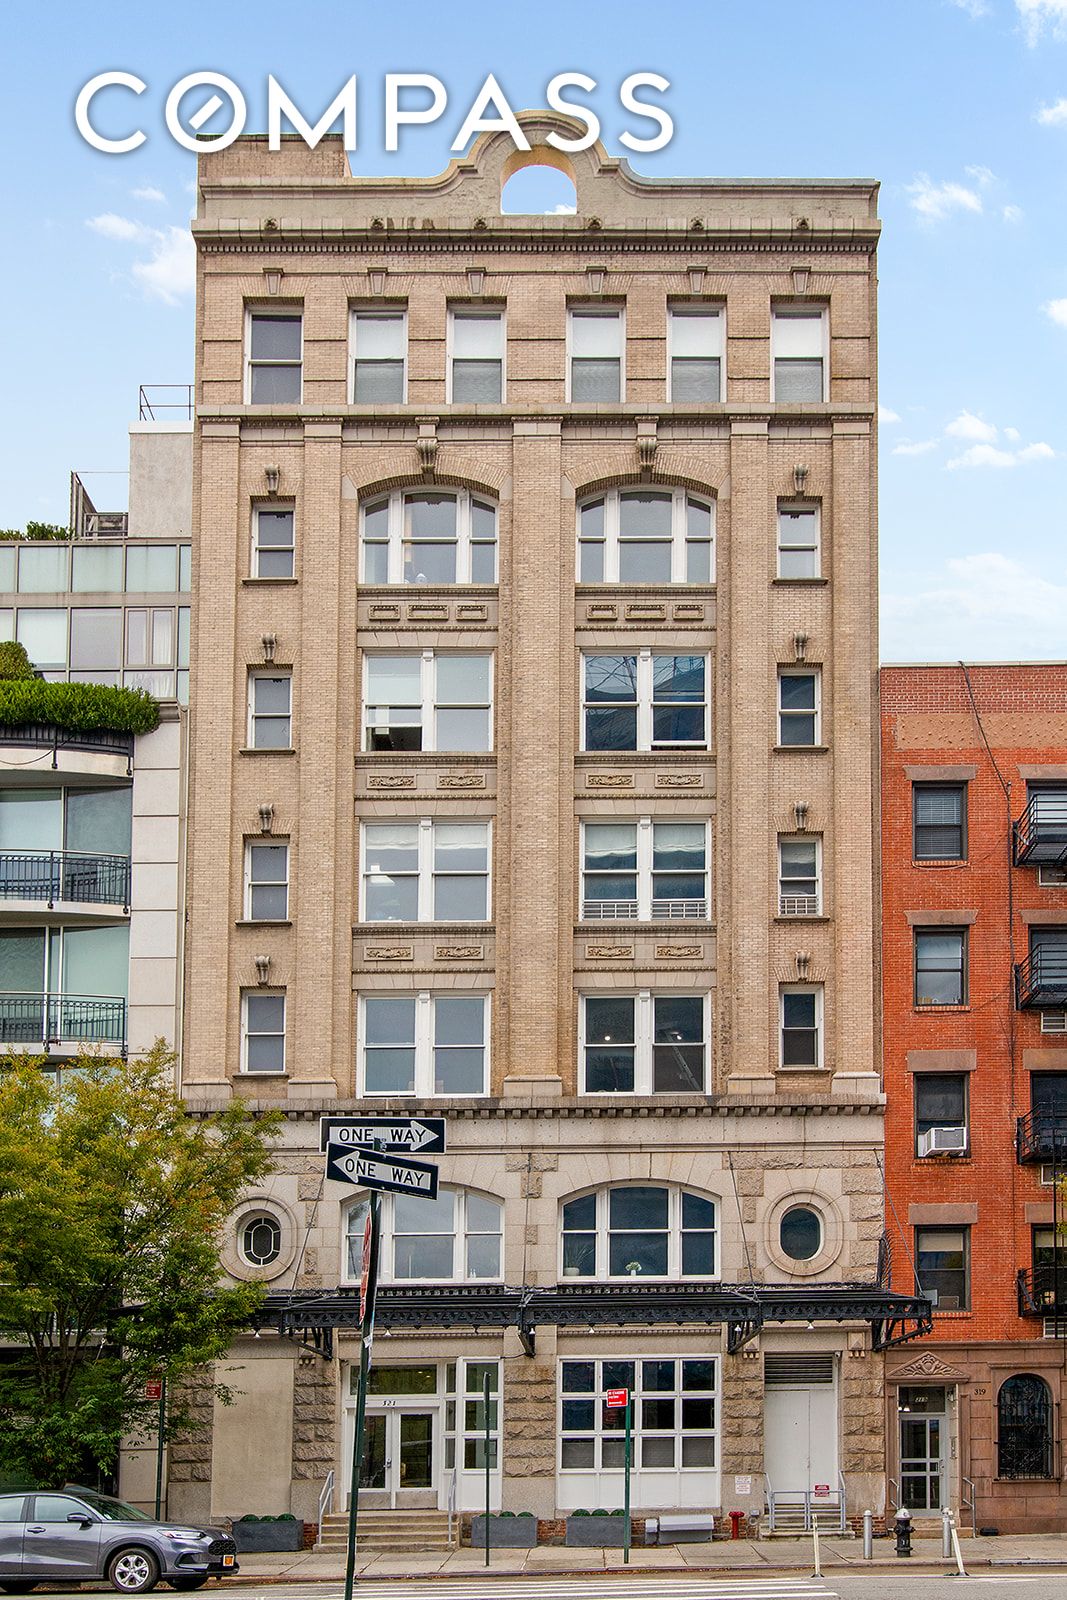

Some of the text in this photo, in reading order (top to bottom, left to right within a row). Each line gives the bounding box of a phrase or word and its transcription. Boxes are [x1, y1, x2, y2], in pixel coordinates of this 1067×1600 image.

[339, 1129, 426, 1142] ONE WAY
[345, 1158, 424, 1186] ONE WAY
[974, 1388, 987, 1396] 319
